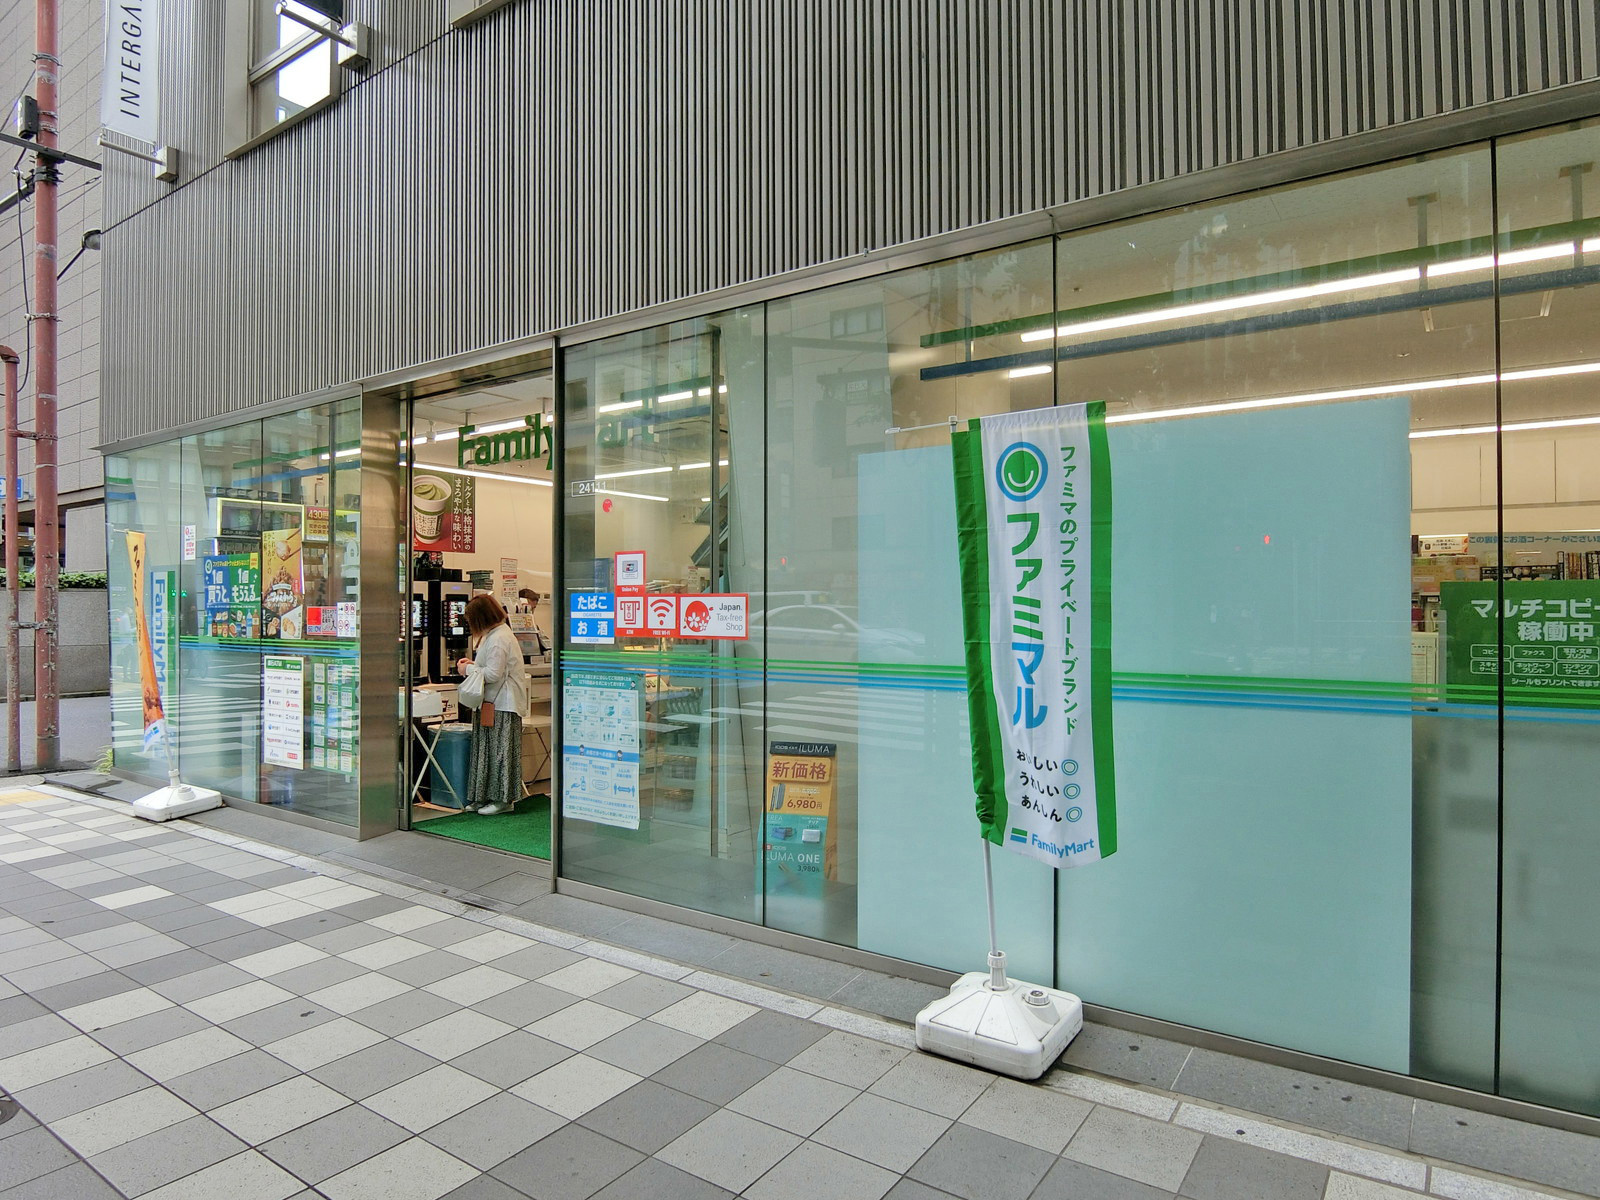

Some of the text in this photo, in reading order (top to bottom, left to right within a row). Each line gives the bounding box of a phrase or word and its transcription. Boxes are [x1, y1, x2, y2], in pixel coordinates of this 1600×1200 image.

[120, 0, 142, 118] INTERGA
[579, 481, 606, 494] 24111
[453, 478, 463, 550] まろやかな味わい
[464, 477, 473, 551] ミルクと本格抹茶の
[231, 584, 256, 603] もらえる
[1060, 446, 1079, 736] ファミマのプライベートブランド
[577, 596, 608, 610] たばこ
[716, 613, 743, 622] Tax-free
[726, 622, 743, 632] Shop
[1007, 512, 1048, 729] ファミマル
[1518, 621, 1593, 642] 稼働中
[798, 744, 830, 753] ILUMA
[772, 760, 827, 780] 新価格
[787, 799, 822, 809] 6,980円
[1021, 794, 1063, 823] あんしん
[1031, 833, 1095, 858] FamilyMart
[797, 853, 820, 864] ONE
